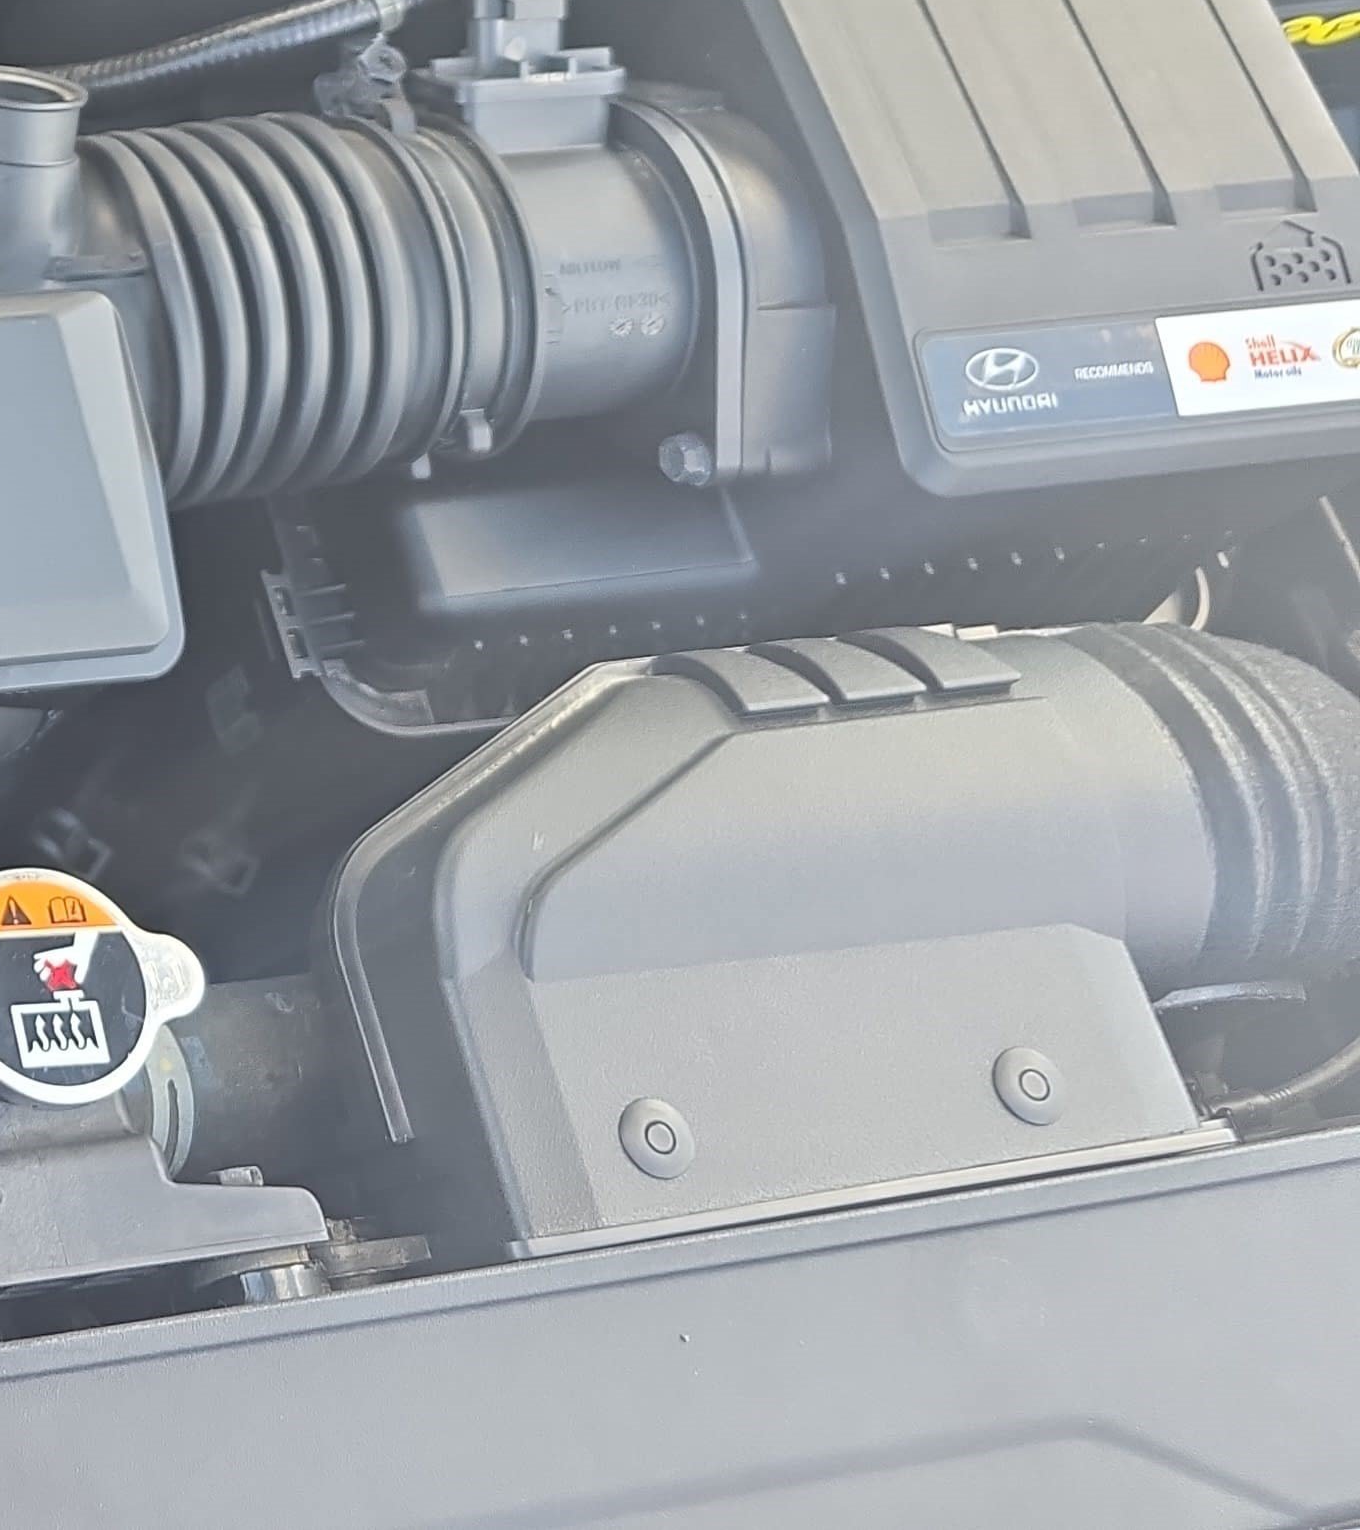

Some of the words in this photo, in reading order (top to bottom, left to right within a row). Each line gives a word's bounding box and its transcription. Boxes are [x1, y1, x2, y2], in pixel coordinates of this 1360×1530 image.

[1247, 347, 1317, 367] HELIX
[1074, 361, 1154, 380] RECOMMENDS
[1254, 368, 1283, 379] Motor
[962, 392, 1059, 417] HYUNDAI
